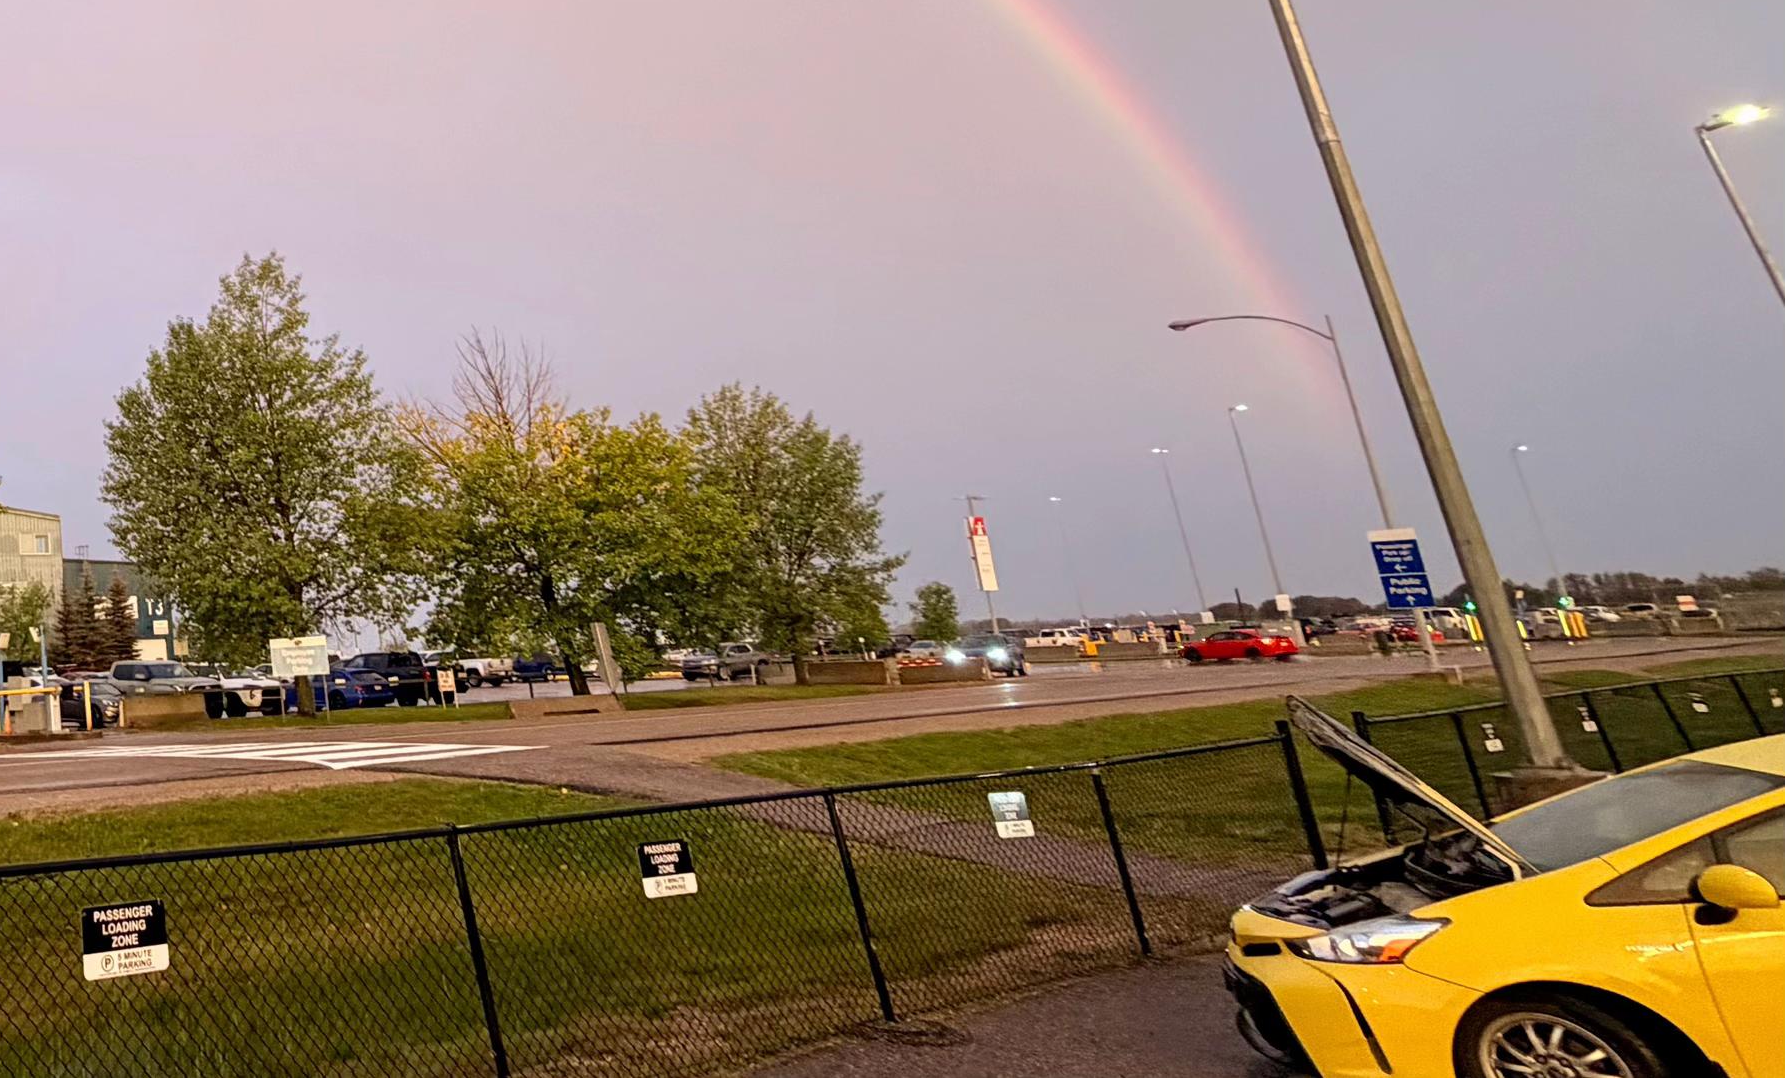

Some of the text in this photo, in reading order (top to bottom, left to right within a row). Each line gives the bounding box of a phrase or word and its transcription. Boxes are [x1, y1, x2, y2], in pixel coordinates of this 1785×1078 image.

[1389, 578, 1422, 586] Public
[1389, 586, 1428, 595] Parking
[644, 842, 682, 855] PASSENGER
[650, 853, 679, 865] LOADING
[658, 864, 676, 874] ZONE
[93, 905, 153, 922] PASSENGER
[102, 919, 146, 935] LOADING
[111, 933, 139, 948] ZONE
[124, 949, 152, 959] MINUTE
[118, 959, 152, 970] PARKING
